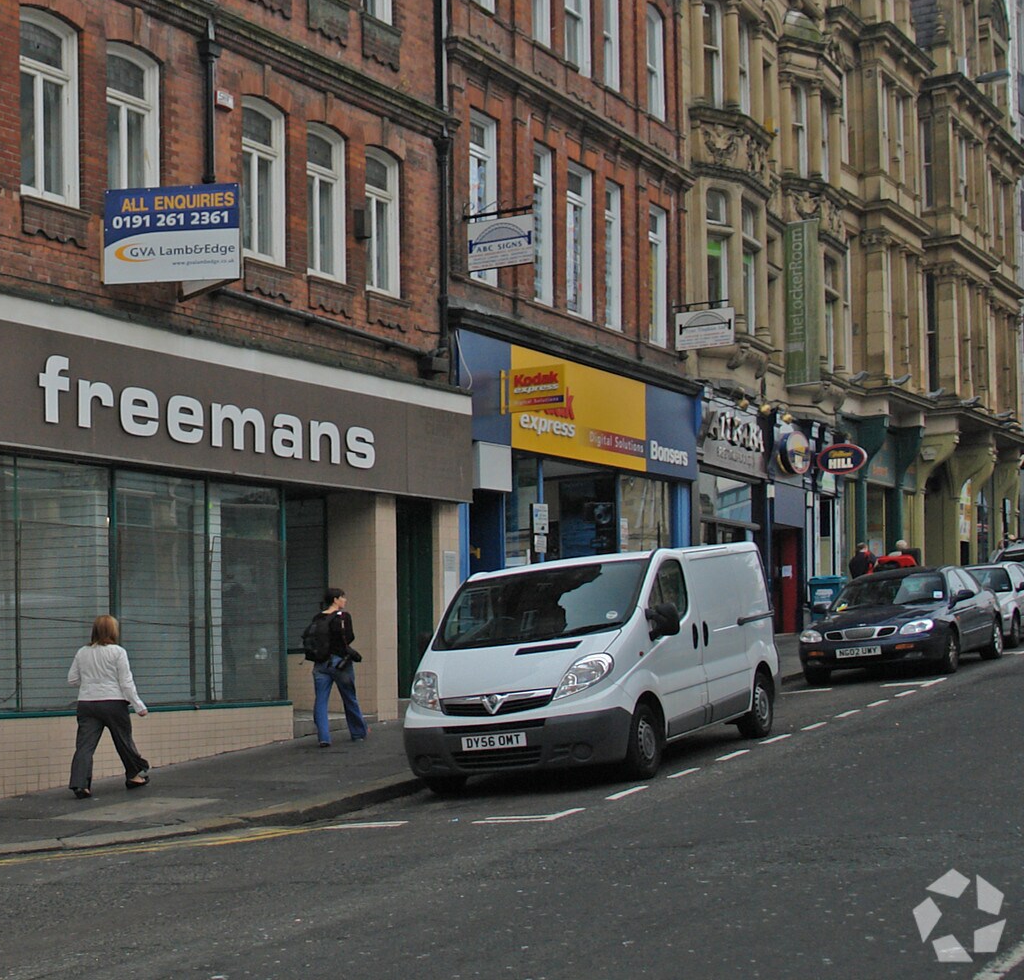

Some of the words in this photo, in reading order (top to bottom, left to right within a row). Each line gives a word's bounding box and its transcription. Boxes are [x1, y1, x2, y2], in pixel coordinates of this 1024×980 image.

[121, 197, 149, 213] ALL
[154, 191, 235, 211] ENQUIRIES
[112, 214, 151, 229] 0191
[156, 212, 184, 227] 261
[190, 210, 229, 225] 2361
[129, 247, 156, 258] GVA
[159, 243, 236, 256] Lamb&Edge
[476, 245, 494, 253] ABC
[497, 240, 523, 250] SIGNS
[513, 371, 559, 387] Kodak
[513, 382, 560, 395] express
[39, 355, 376, 469] freemans
[519, 413, 576, 438] express
[589, 430, 613, 448] Digital
[614, 435, 645, 453] Solutions
[650, 440, 689, 467] Bonsers
[828, 457, 854, 470] HILL
[465, 735, 496, 749] DY56
[498, 733, 521, 747] OMT
